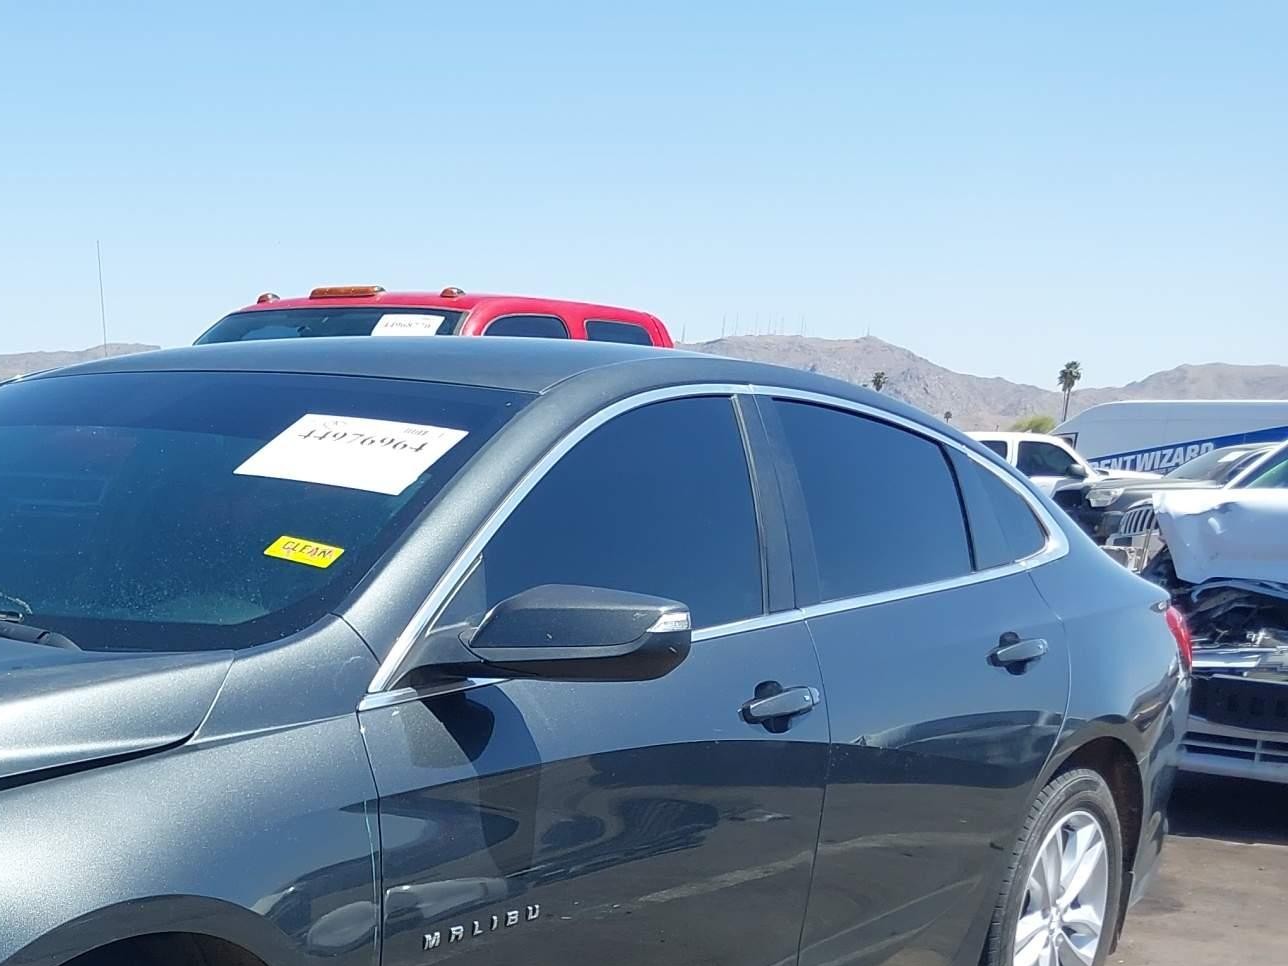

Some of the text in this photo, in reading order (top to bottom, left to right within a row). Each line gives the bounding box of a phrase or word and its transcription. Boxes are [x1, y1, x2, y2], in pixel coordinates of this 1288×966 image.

[298, 429, 428, 453] 44976964
[281, 540, 333, 559] CLEAN
[423, 904, 540, 951] MALIBU
